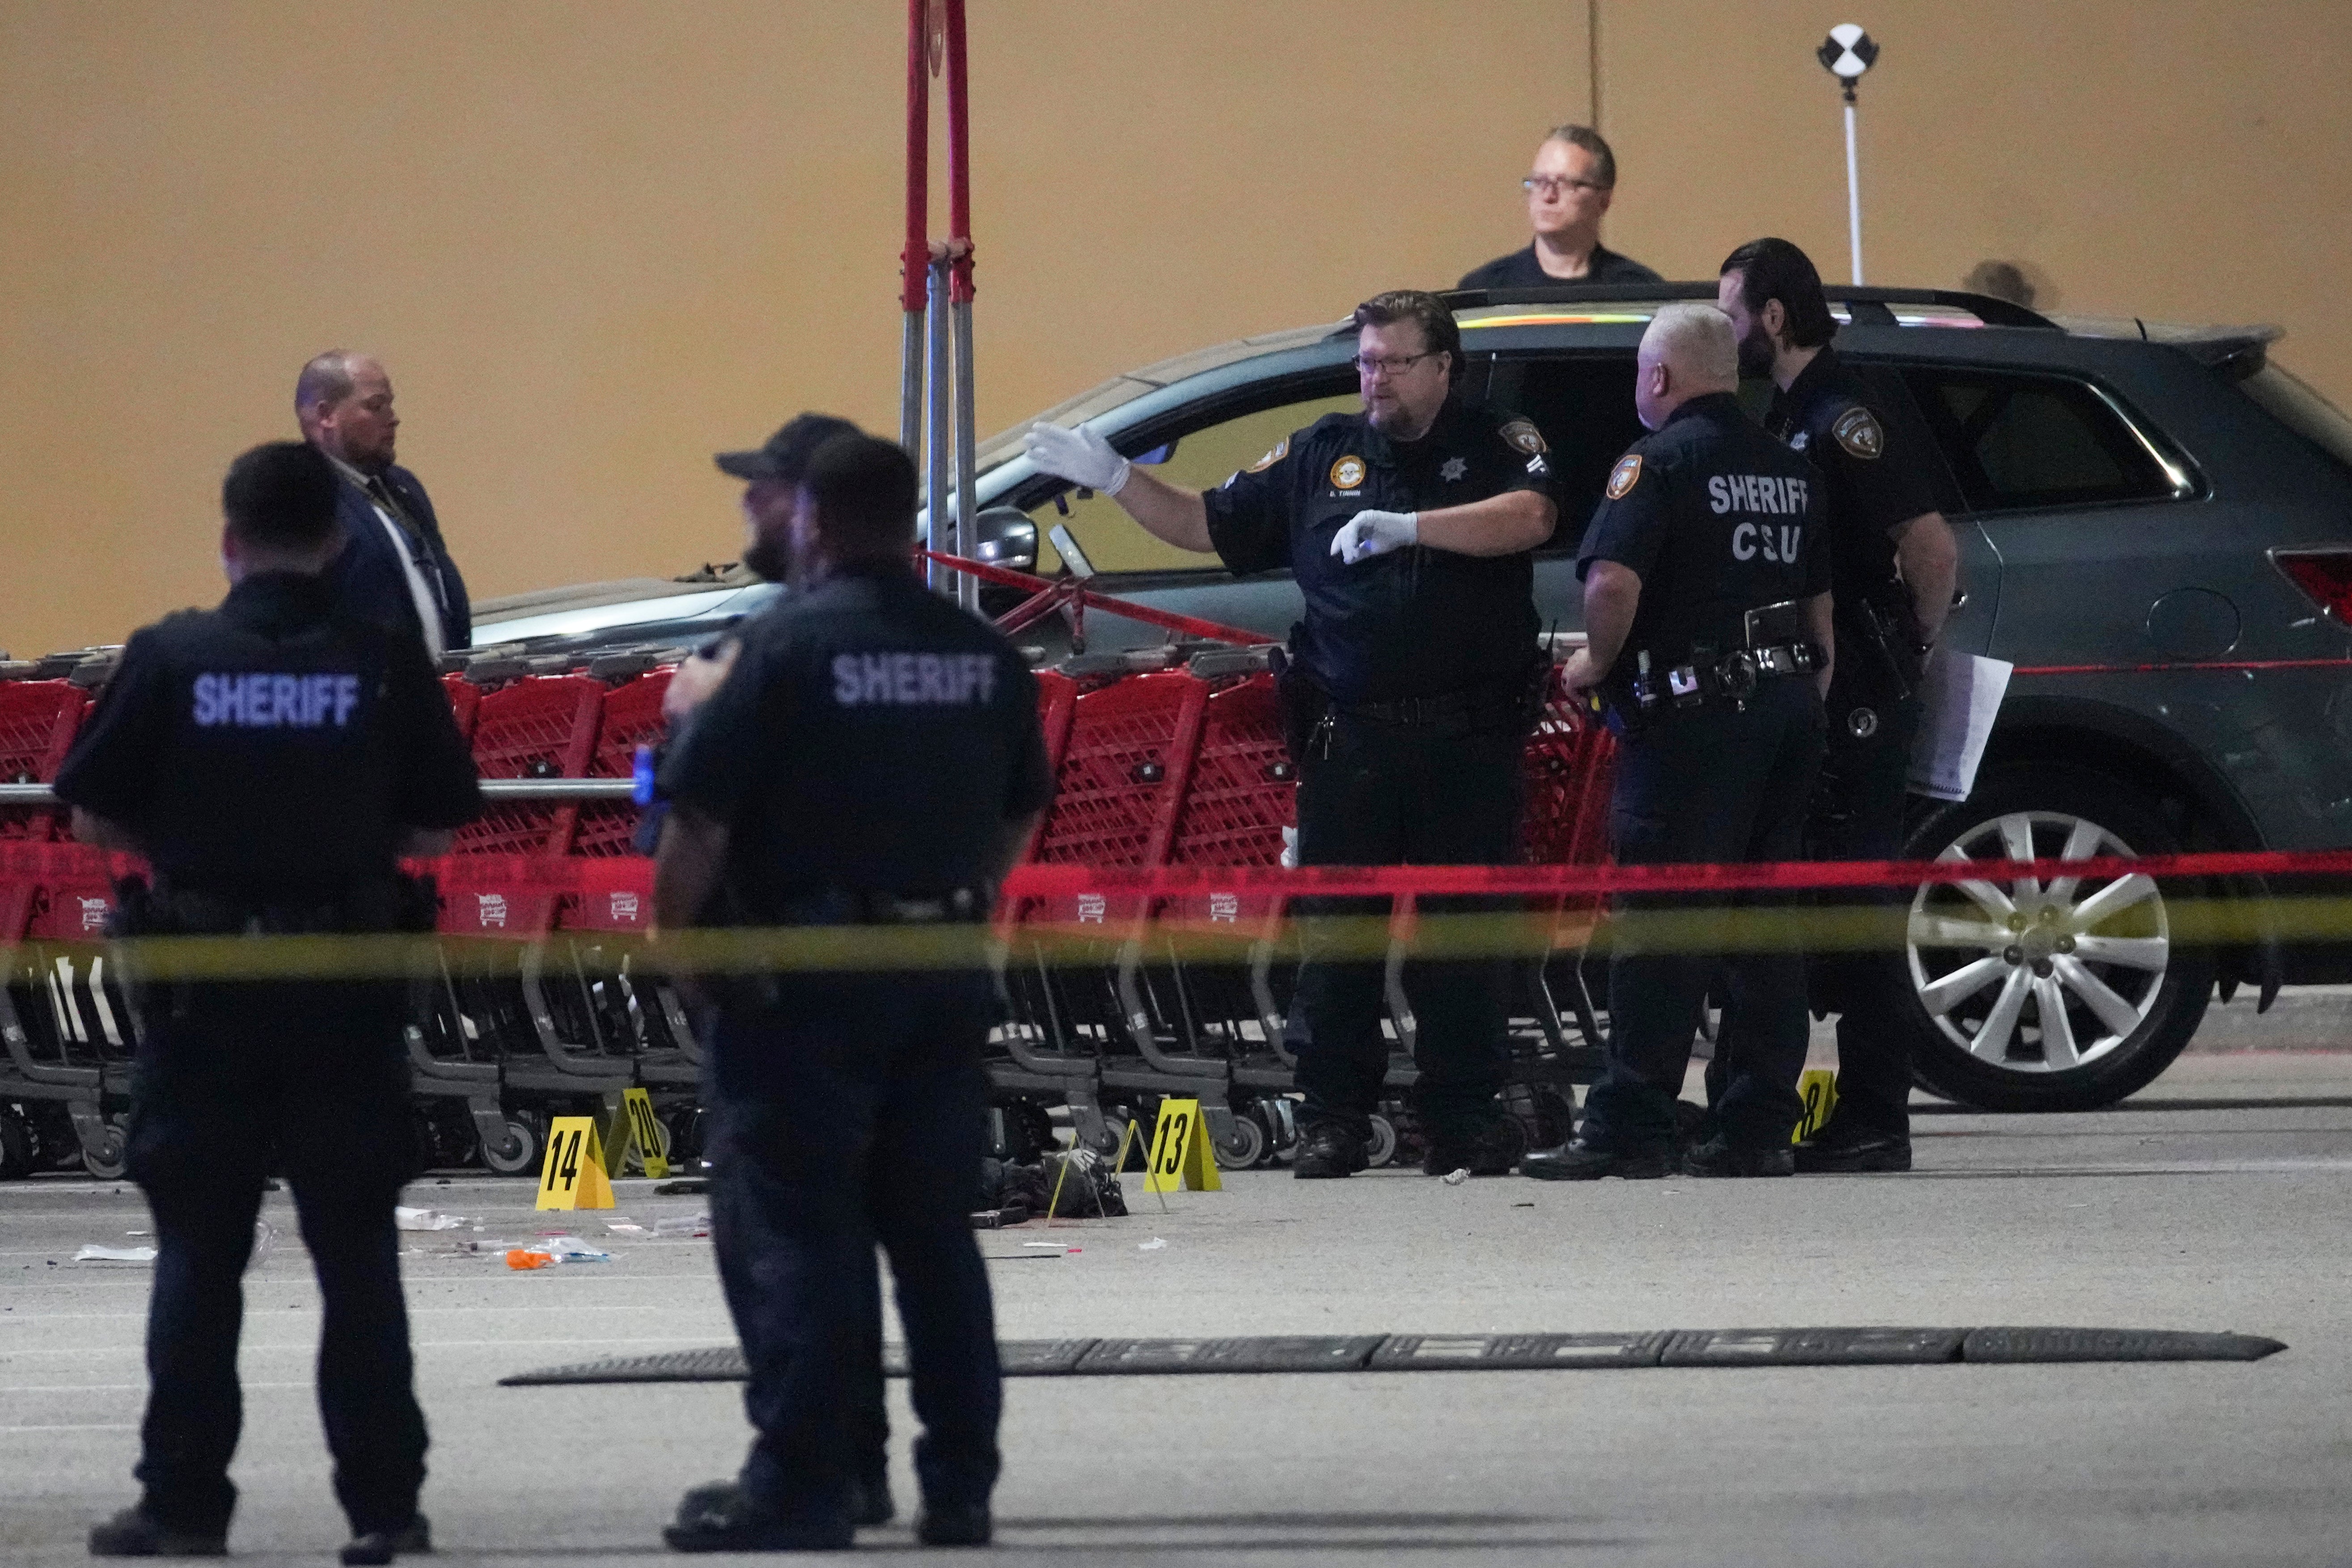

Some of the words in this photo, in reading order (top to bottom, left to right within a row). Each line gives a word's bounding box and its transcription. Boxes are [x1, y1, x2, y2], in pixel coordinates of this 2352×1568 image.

[1709, 474, 1808, 514] SHERIFF
[1733, 522, 1800, 563] CSU
[193, 674, 359, 726] SHERIFF
[833, 653, 994, 704] SHERIFF
[629, 1098, 661, 1158] 20
[1155, 1113, 1188, 1175] 13
[547, 1130, 582, 1191] 14
